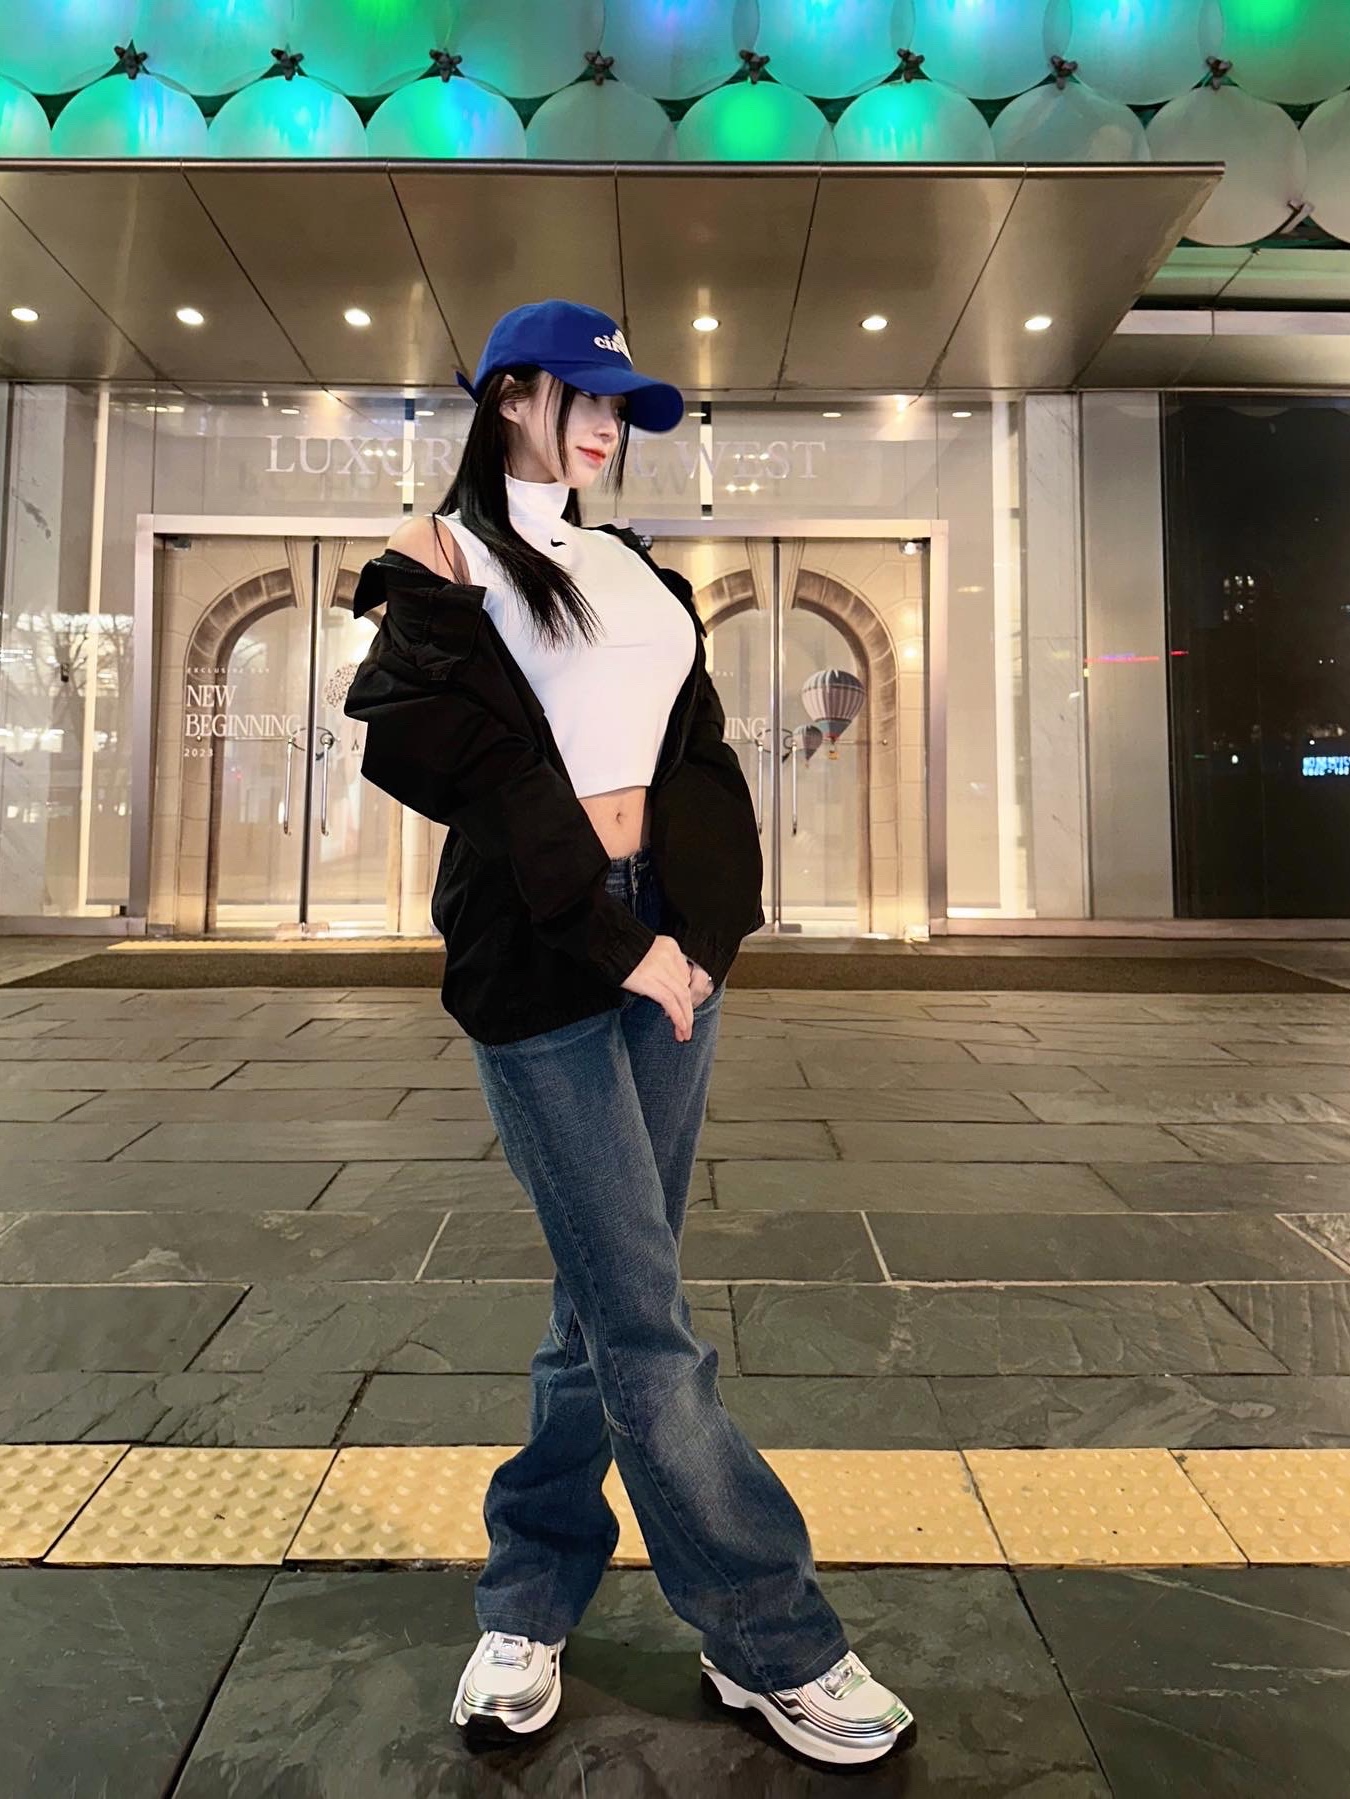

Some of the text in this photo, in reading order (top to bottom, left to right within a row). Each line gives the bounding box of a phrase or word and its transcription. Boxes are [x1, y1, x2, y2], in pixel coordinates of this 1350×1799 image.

[264, 435, 470, 477] LUXUR
[674, 440, 826, 480] WEST
[186, 684, 238, 708] NEW
[185, 713, 302, 738] BEGINNING
